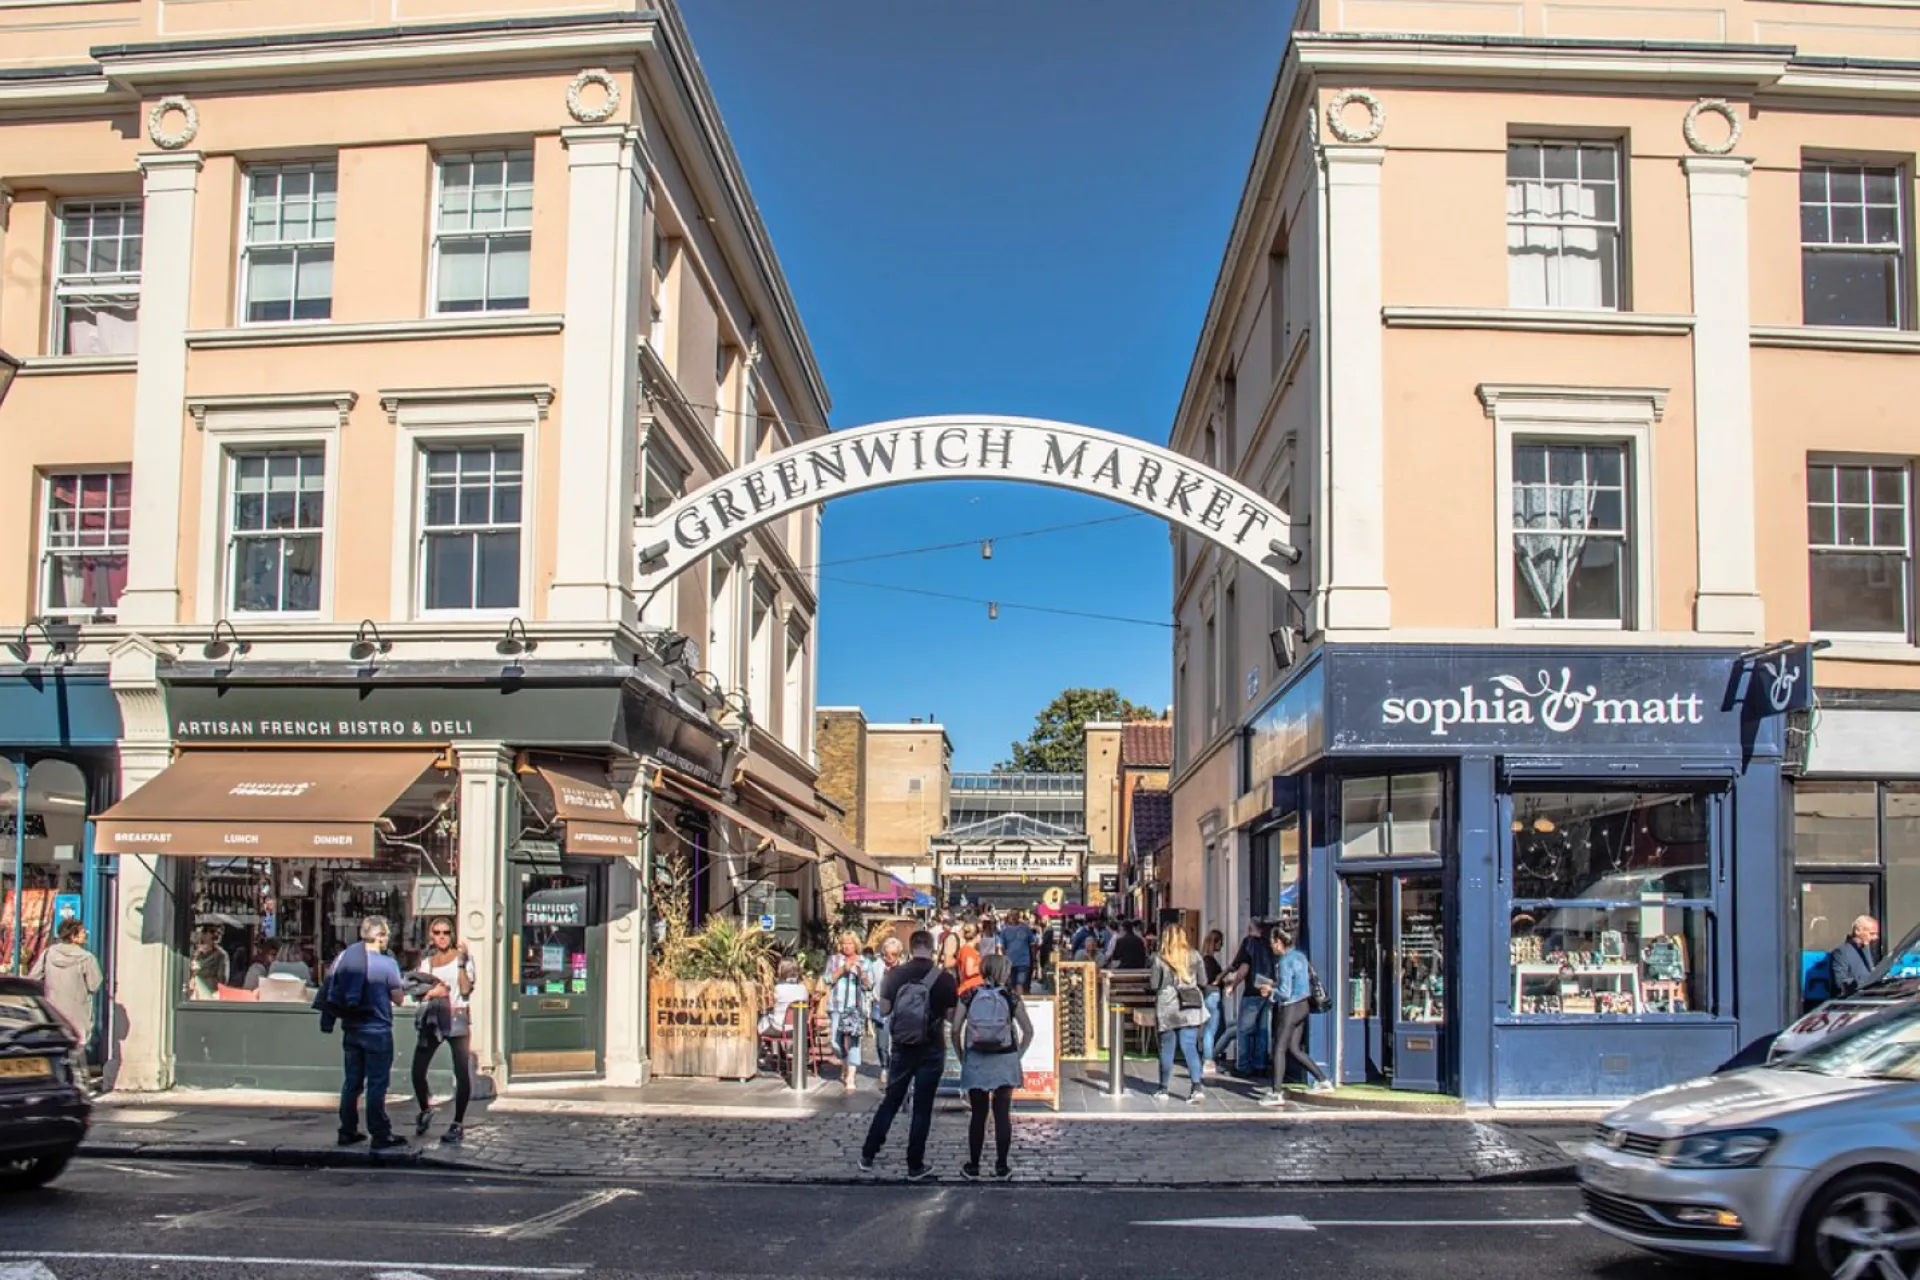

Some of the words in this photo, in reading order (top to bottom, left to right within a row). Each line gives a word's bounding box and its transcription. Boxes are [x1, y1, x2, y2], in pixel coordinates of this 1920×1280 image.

[674, 427, 1013, 550] GREENWICH
[1042, 433, 1270, 546] MARKET
[1381, 685, 1534, 735] sophia
[1592, 691, 1704, 723] matt
[177, 720, 253, 735] ARTISAN
[260, 720, 331, 735] FRENCH
[338, 720, 405, 735] BISTRO
[411, 720, 423, 735] &
[430, 720, 473, 735] DELI
[114, 832, 173, 844] BREAKFAST
[224, 833, 259, 844] LUNCH
[313, 835, 353, 845] DINNER
[573, 832, 619, 842] AFTERNOON
[619, 835, 634, 844] TEA
[657, 1011, 740, 1026] FROMAGE
